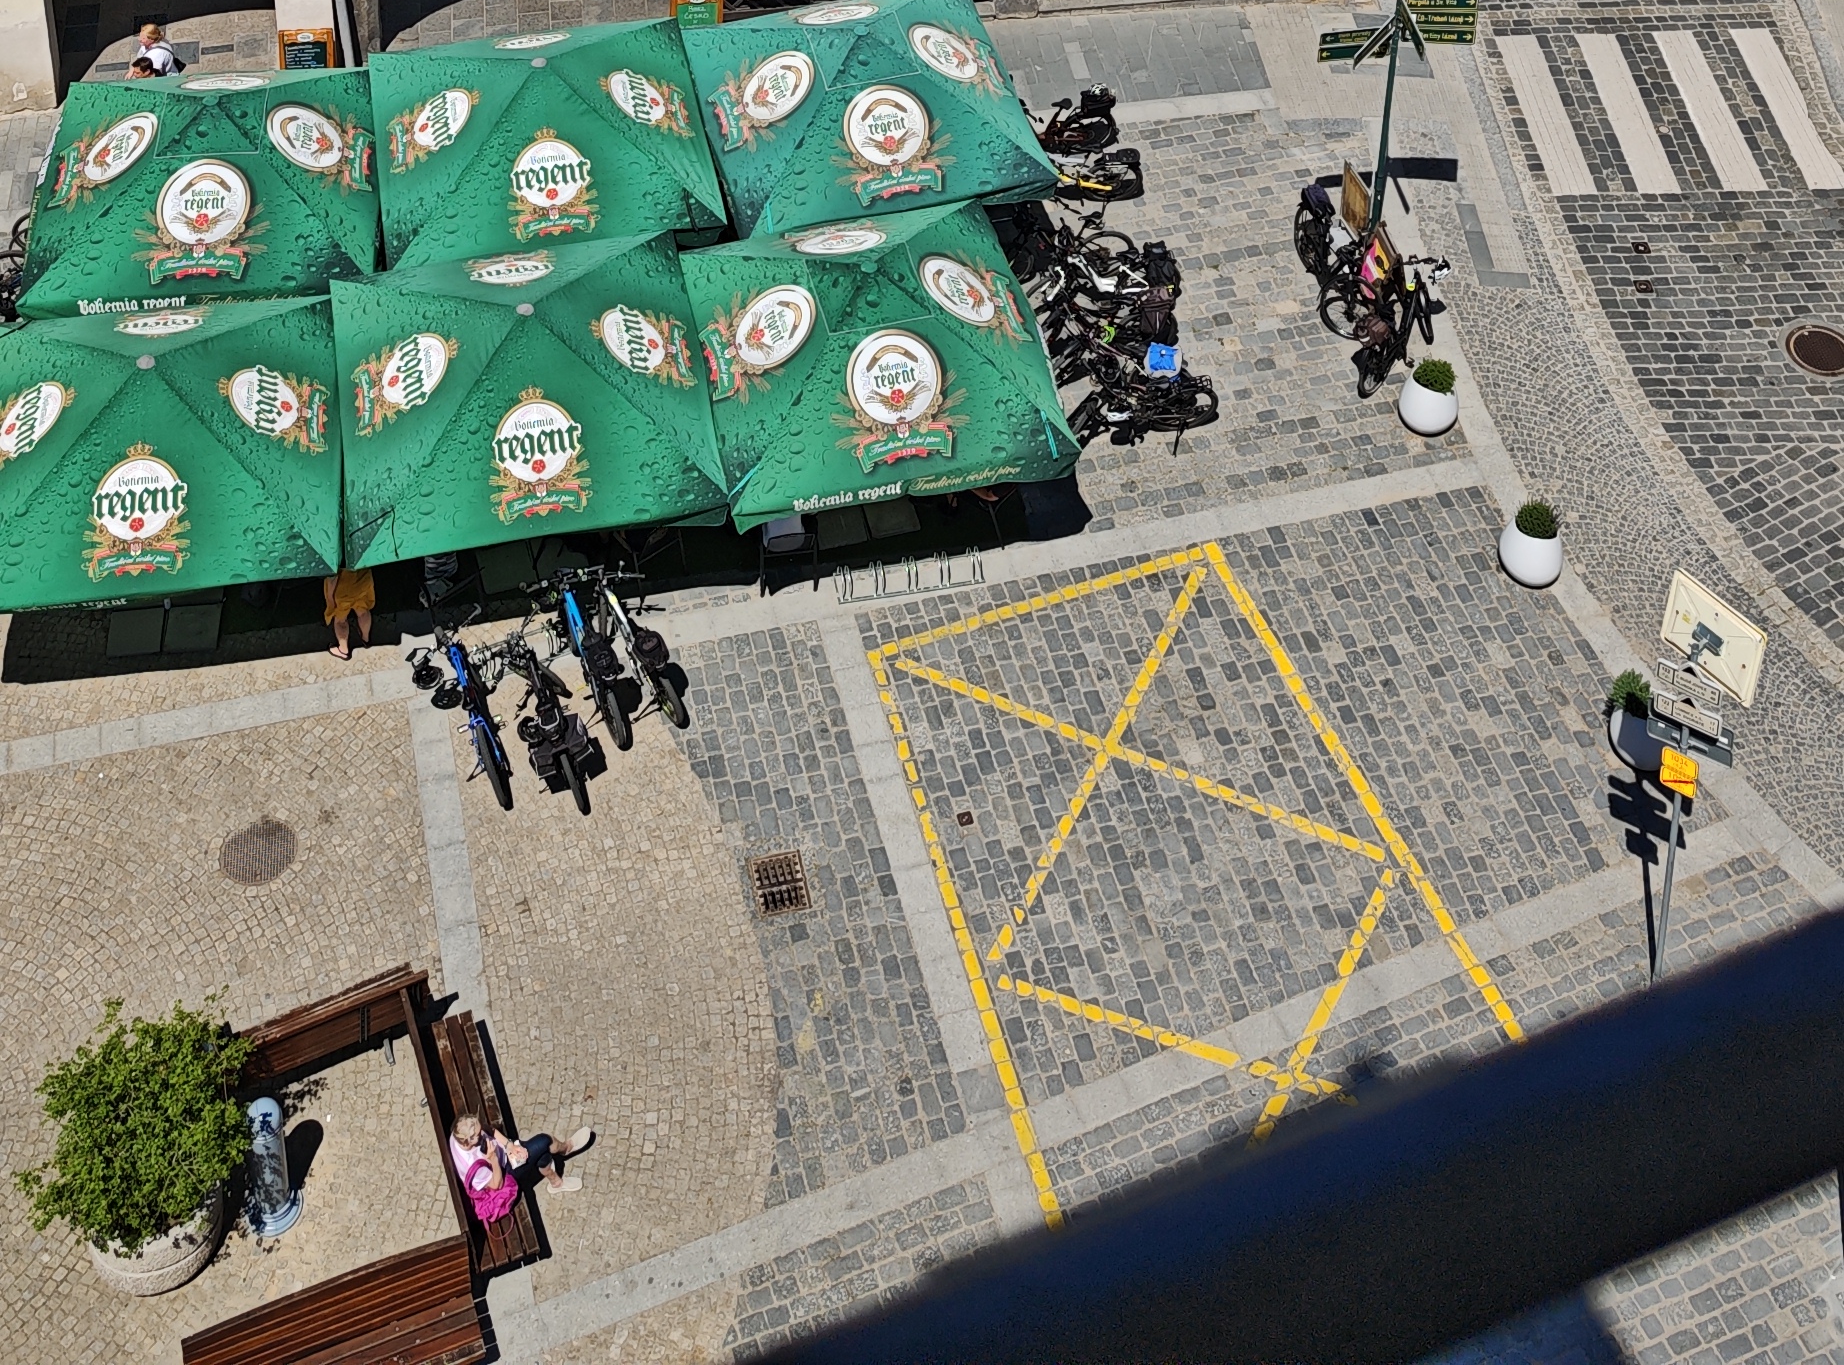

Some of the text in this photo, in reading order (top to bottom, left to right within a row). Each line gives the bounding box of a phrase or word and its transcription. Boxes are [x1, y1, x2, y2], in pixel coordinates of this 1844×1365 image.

[868, 117, 906, 136] regent
[513, 160, 589, 192] regent
[184, 195, 225, 212] regent
[77, 297, 139, 316] Bohemia
[619, 306, 651, 371] regent
[396, 336, 427, 407] regent
[874, 367, 917, 389] regent
[254, 367, 282, 433] regent
[13, 385, 43, 455] regent
[495, 424, 580, 465] regent
[95, 482, 185, 522] regent
[792, 492, 854, 511] Bohemia
[858, 479, 904, 500] regent
[910, 474, 964, 491] Tradiční
